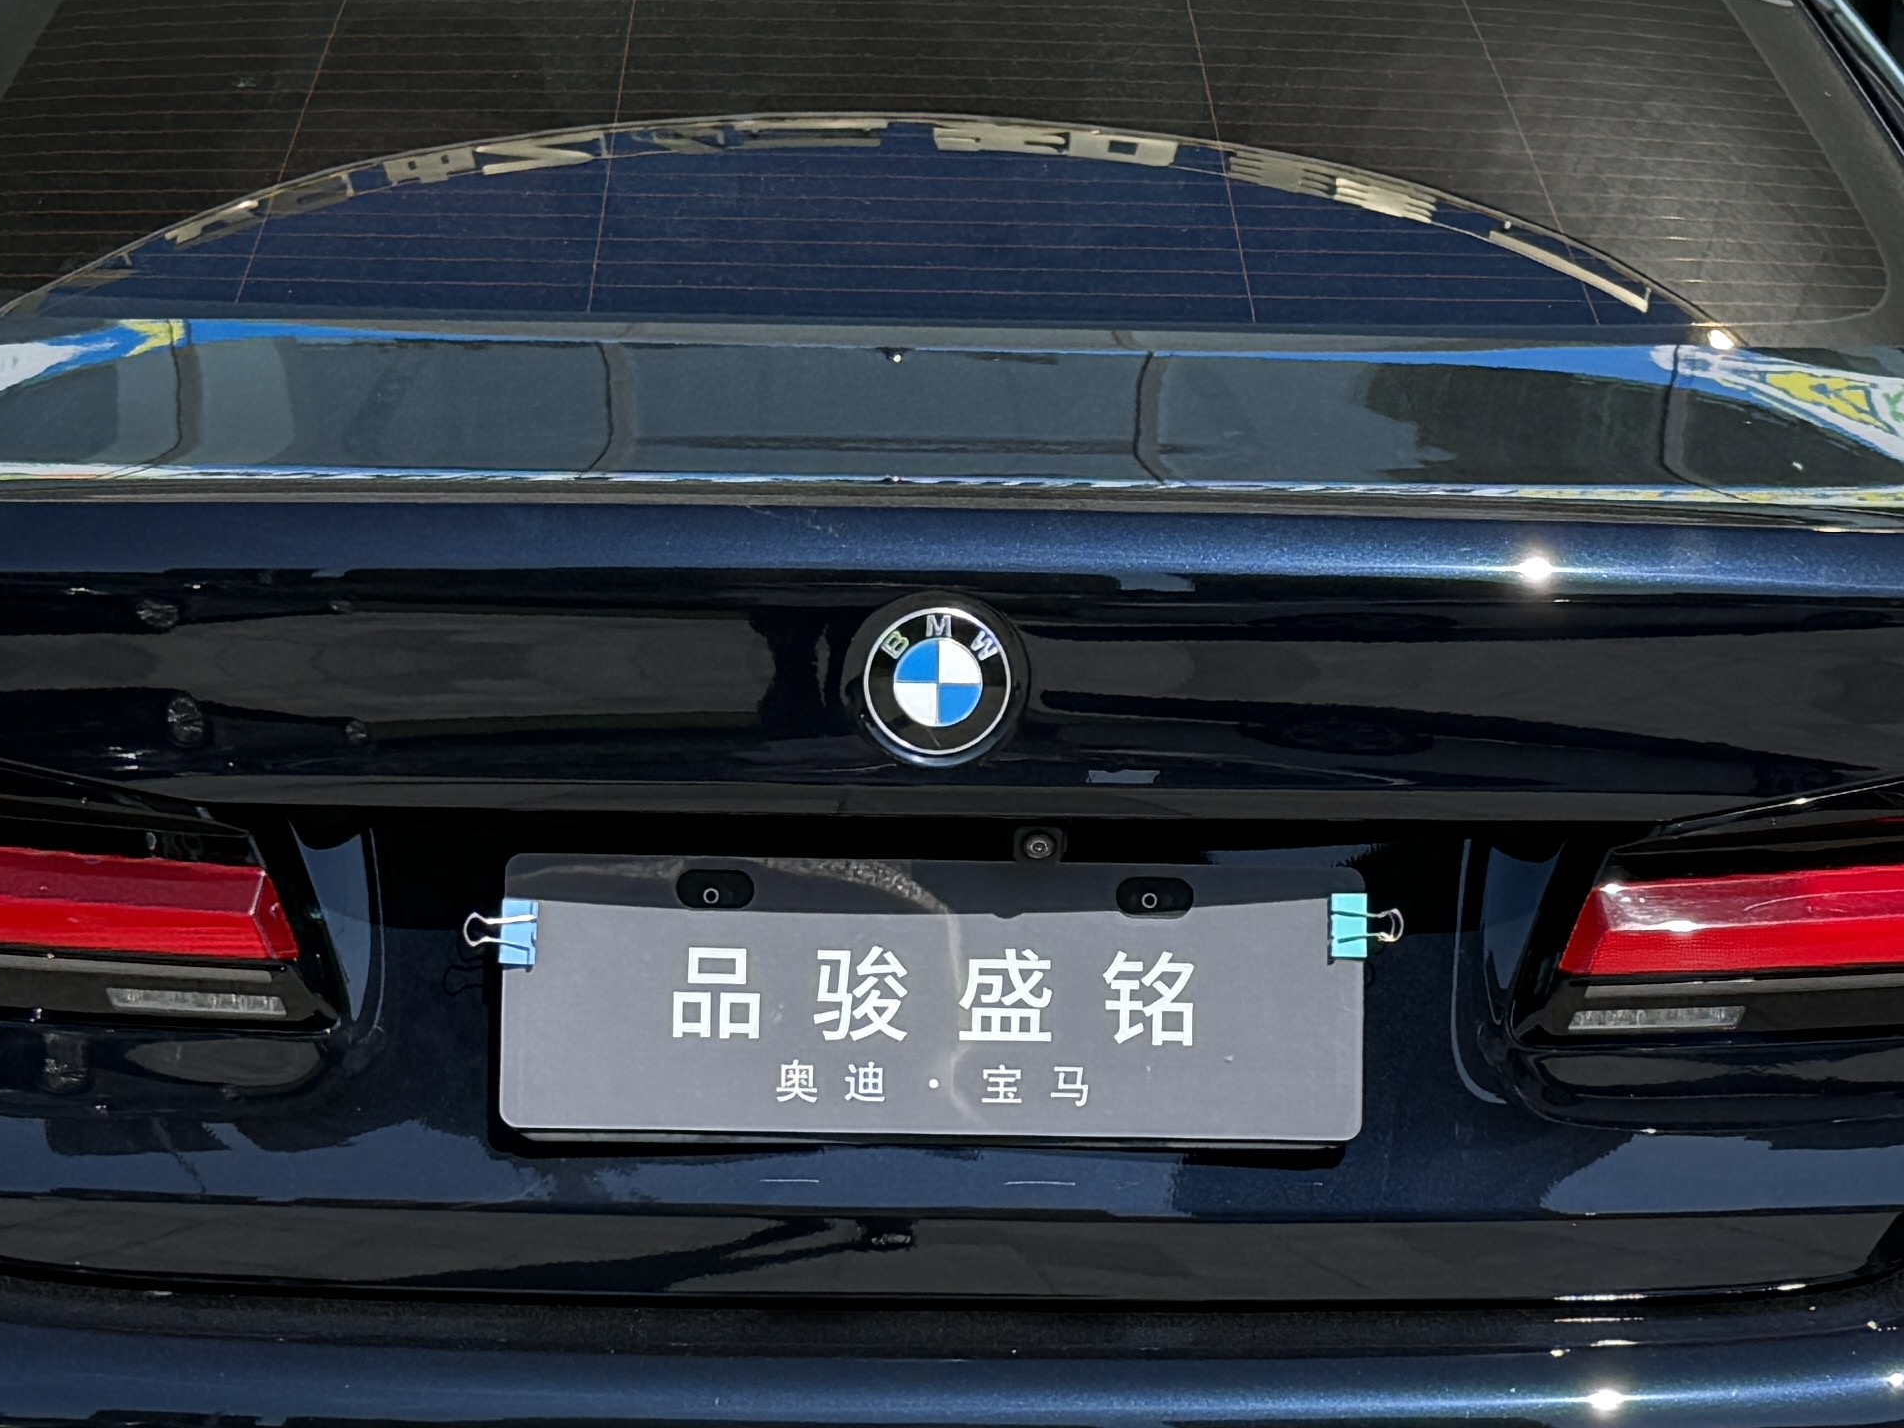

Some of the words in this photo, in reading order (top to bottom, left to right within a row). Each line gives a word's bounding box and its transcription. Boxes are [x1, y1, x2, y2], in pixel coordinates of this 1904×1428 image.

[884, 612, 1000, 662] BMW
[670, 944, 1197, 1048] 品骏盛铭
